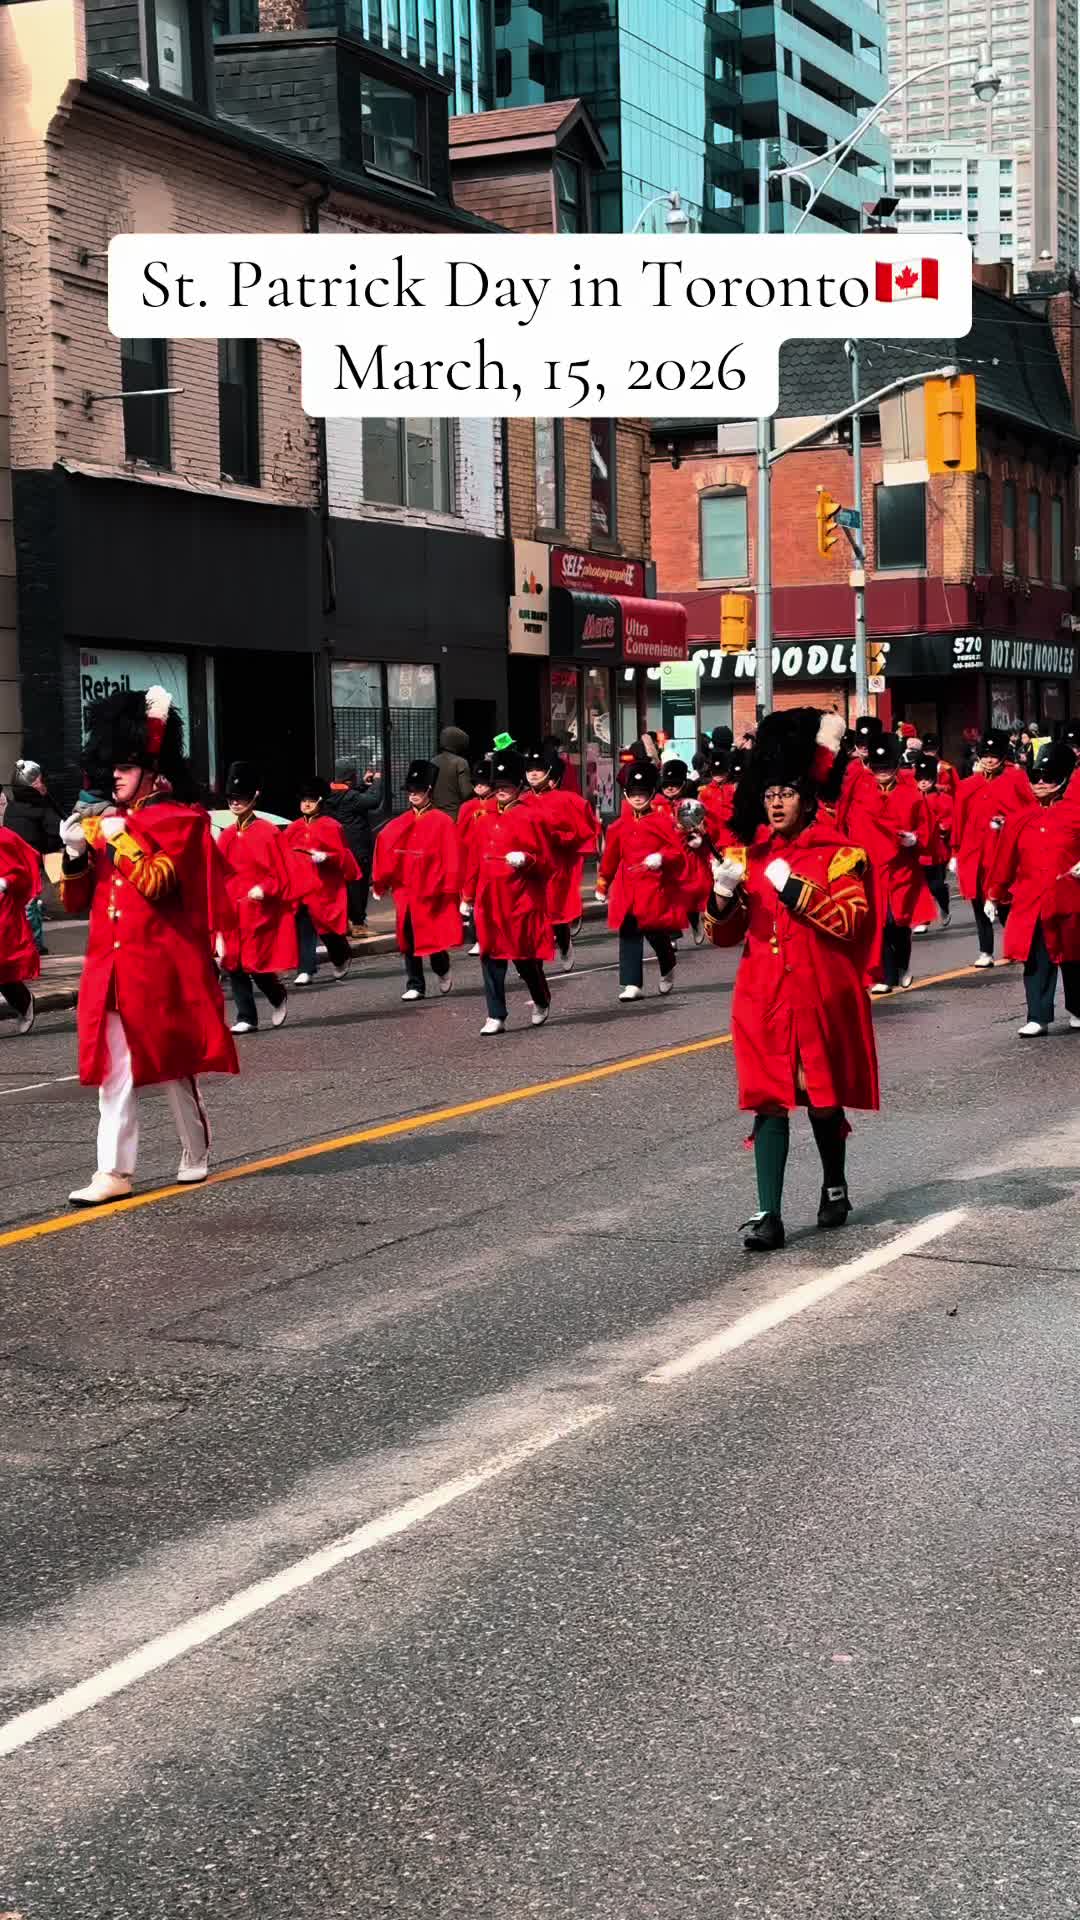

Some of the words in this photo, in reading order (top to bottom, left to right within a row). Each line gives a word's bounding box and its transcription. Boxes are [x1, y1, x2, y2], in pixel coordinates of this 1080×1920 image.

[625, 617, 649, 637] Ultra
[625, 636, 683, 658] Convenience
[953, 636, 982, 654] 570
[990, 639, 1010, 669] NOT
[1011, 641, 1032, 670] JUST
[1034, 643, 1075, 674] NOODLES
[81, 674, 130, 700] Retail
